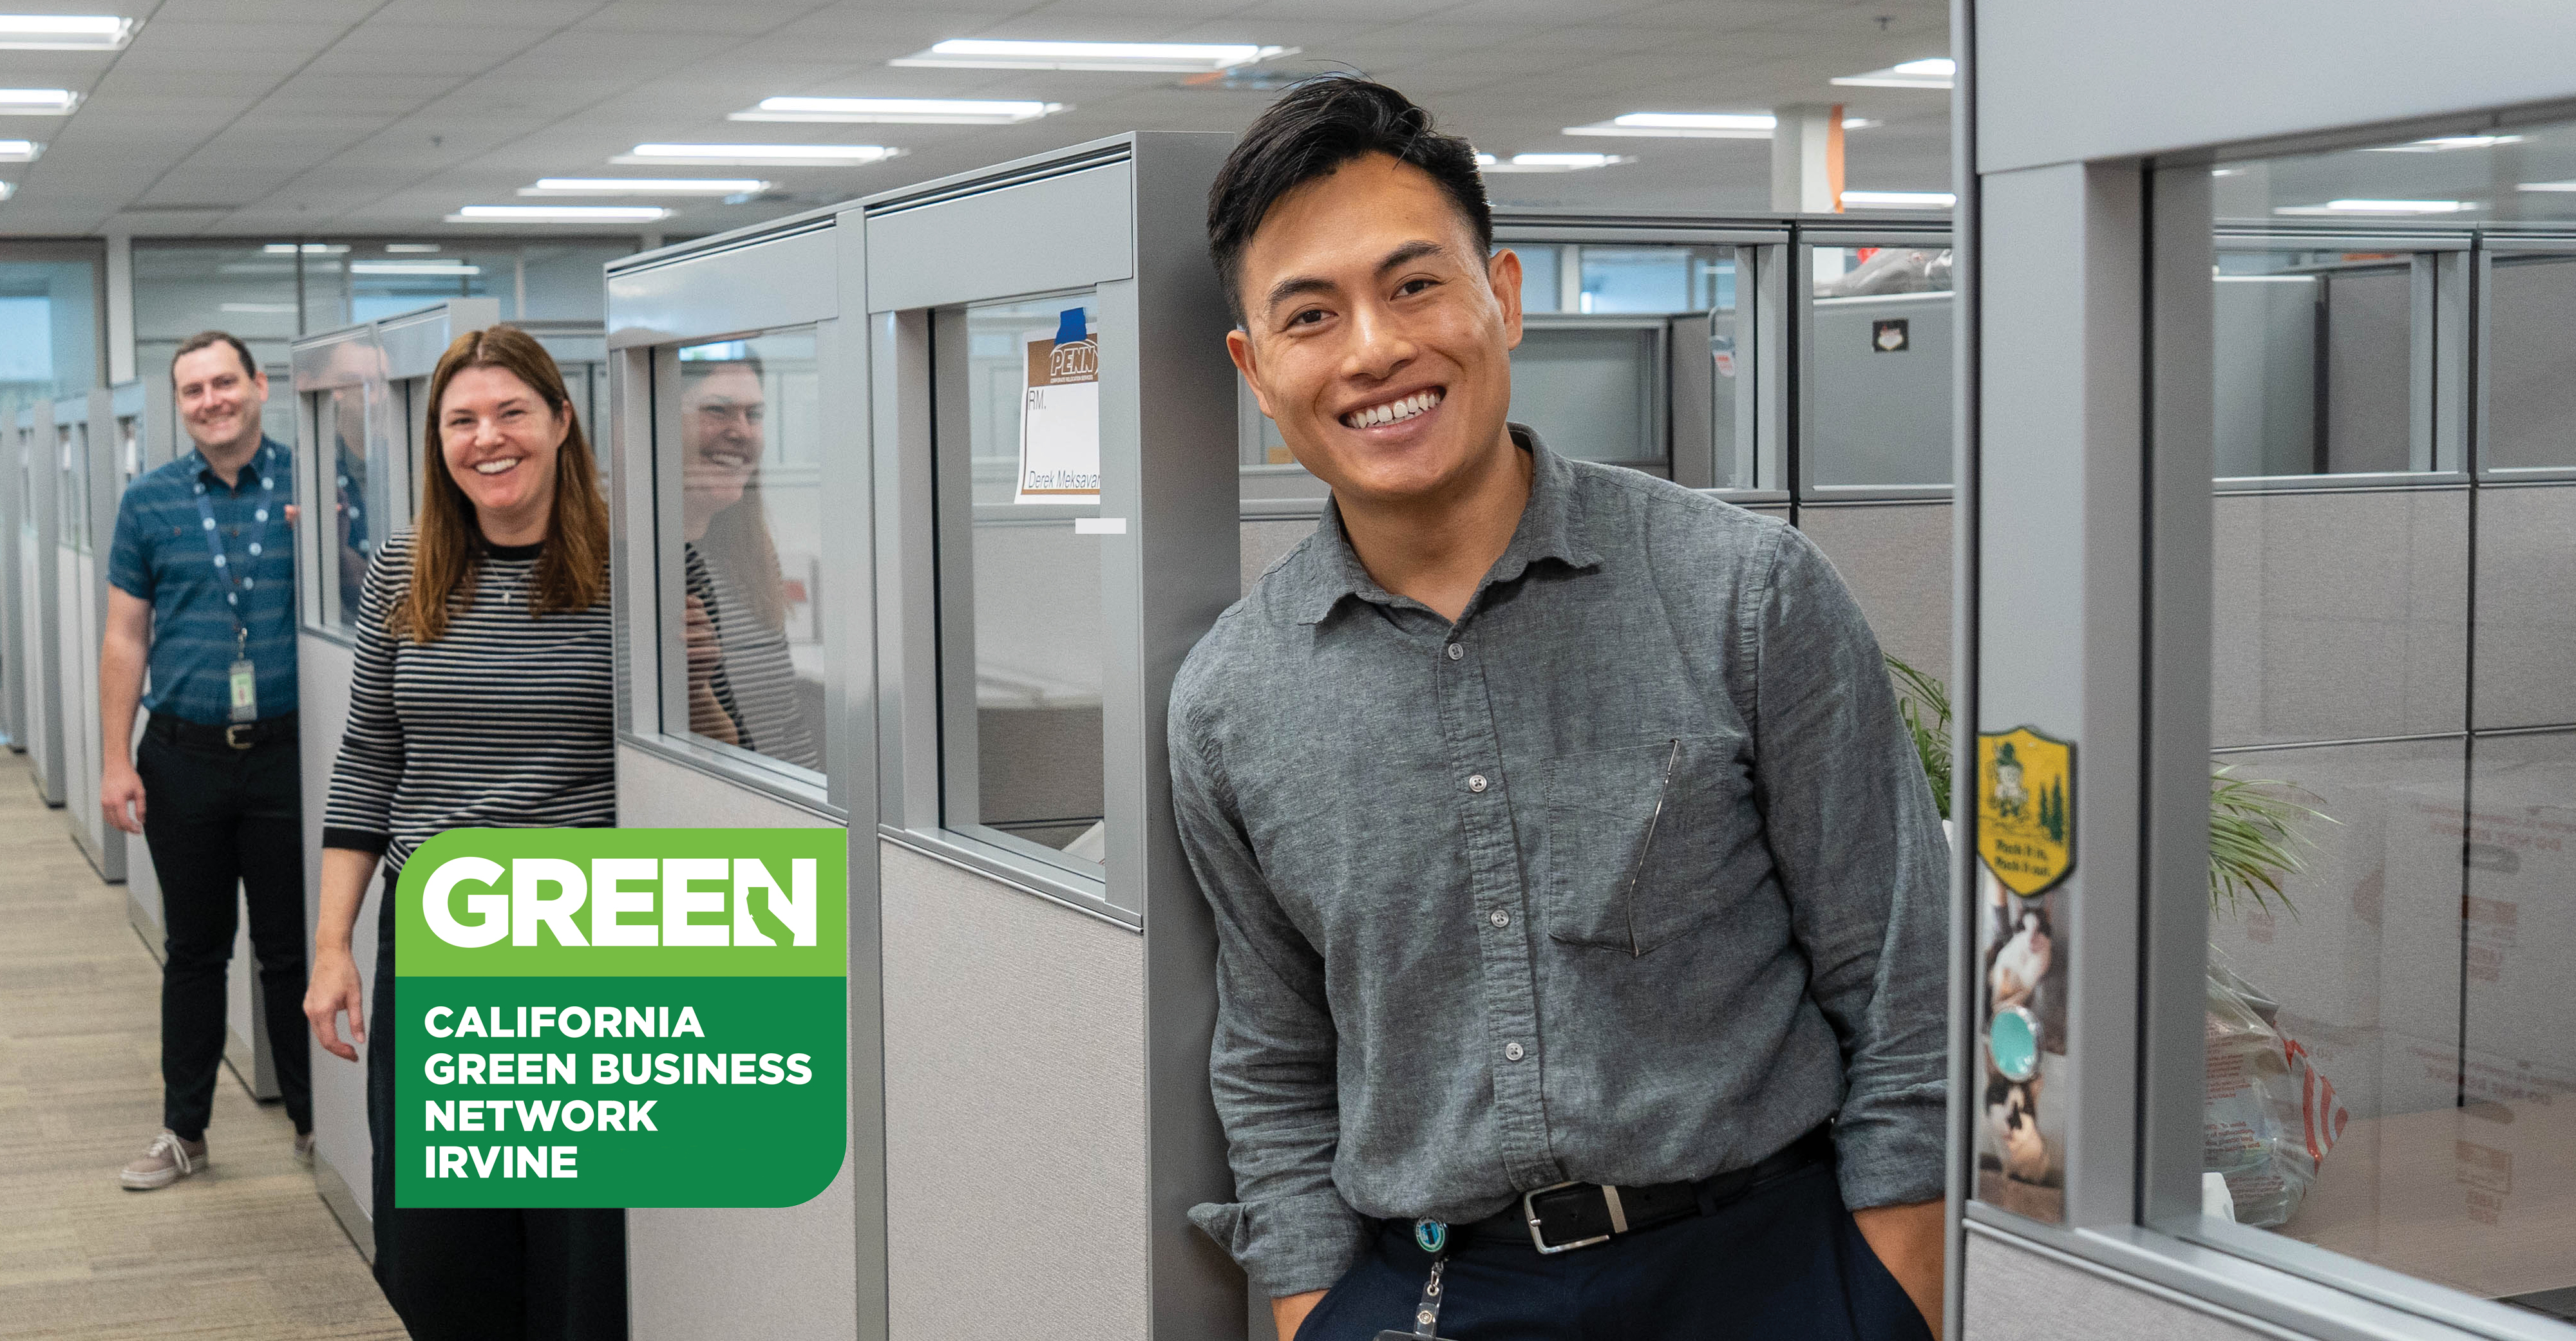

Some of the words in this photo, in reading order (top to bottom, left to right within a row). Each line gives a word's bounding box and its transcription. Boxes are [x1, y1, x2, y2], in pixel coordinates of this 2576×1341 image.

[1050, 346, 1095, 376] PENN
[1029, 389, 1046, 410] RM.
[1029, 470, 1055, 488] Derek
